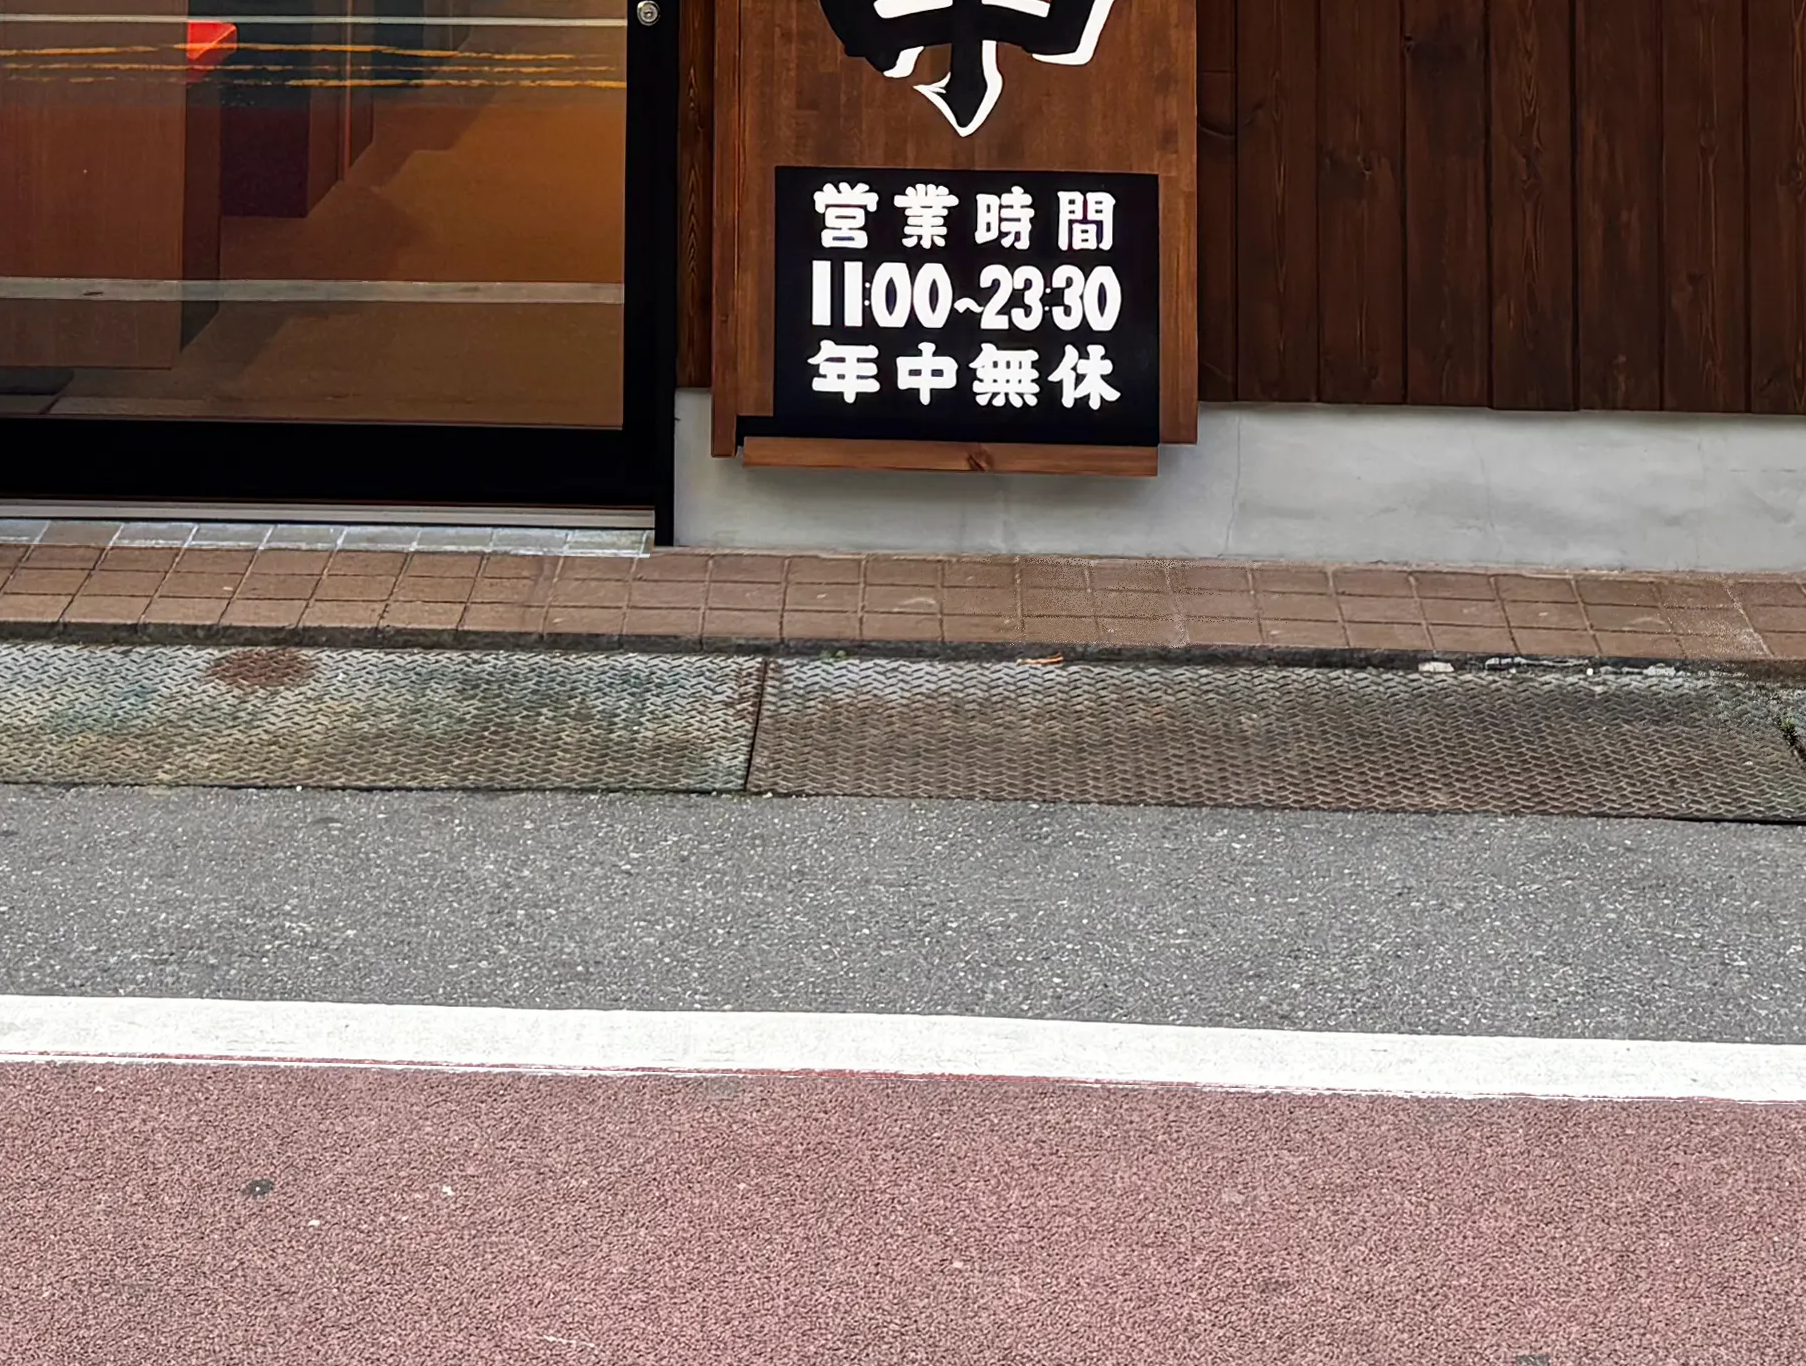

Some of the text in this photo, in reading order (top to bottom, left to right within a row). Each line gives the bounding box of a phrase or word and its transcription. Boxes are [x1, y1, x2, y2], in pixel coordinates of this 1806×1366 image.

[812, 181, 1117, 251] 営業時間
[807, 338, 1122, 411] 年中無休
